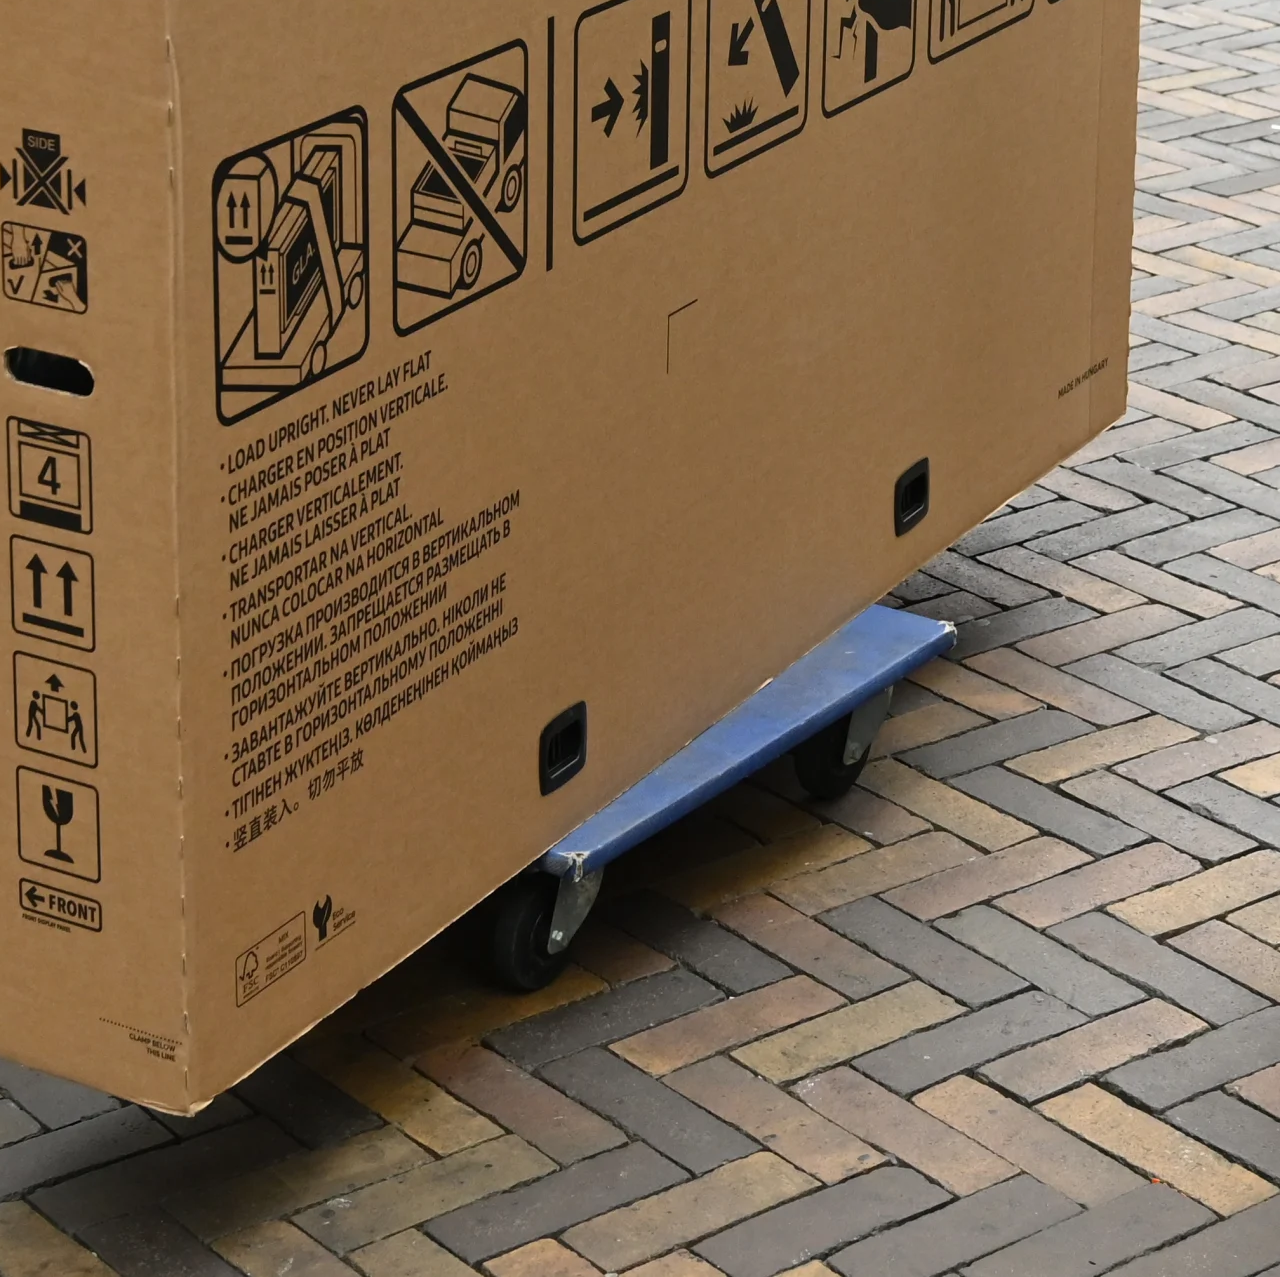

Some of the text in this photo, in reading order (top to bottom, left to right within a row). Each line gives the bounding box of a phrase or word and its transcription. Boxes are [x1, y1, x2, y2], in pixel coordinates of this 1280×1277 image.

[27, 135, 56, 152] SIDE
[291, 241, 316, 286] GLA
[228, 350, 432, 474] LOAD UPRIGHT. NEVER LAY FLAT
[1058, 357, 1108, 400] MADE IN HUNGARY
[37, 456, 61, 496] 4
[228, 373, 448, 506] CHARGER EN POSITION VERTICALE.
[228, 428, 391, 533] NE JAMAIS POSER À PLAT
[229, 452, 404, 564] CHARGER VERTICALEMENT.
[230, 477, 401, 591] NE JAMAIS LAISSER À PLAT
[230, 504, 413, 622] TRANSPORTAR NA VERTICAL.
[230, 508, 444, 650] NUNCA COLOCAR NA HORIZONTAL
[231, 489, 520, 681] ПОГРУЗКА ПРОИЗВОДИТСЯ В ВЕРТИКАЛЬНОМ
[231, 519, 511, 706] ПОЛОЖЕНИИ. ЗАПРЕЩАЕТСЯ РАЗМЕЩАТЬ В
[231, 581, 447, 732] ГОРИЗОНТАЛЬНОМ ПОЛОЖЕНИИ
[231, 572, 506, 763] ЗАВАНТАЖУЙТЕ ВЕРТИКАЛЬНО. НІКОЛИ НЕ
[232, 598, 503, 788] СТАВТЕ В ГОРИЗОНТАЛЬНОМУ ПОЛОЖЕННІ
[49, 894, 96, 923] FRONT
[332, 908, 344, 920] Eco
[243, 975, 260, 994] FSC
[129, 1033, 175, 1052] CLAMP BELOW
[147, 1047, 176, 1062] THIS LINE
